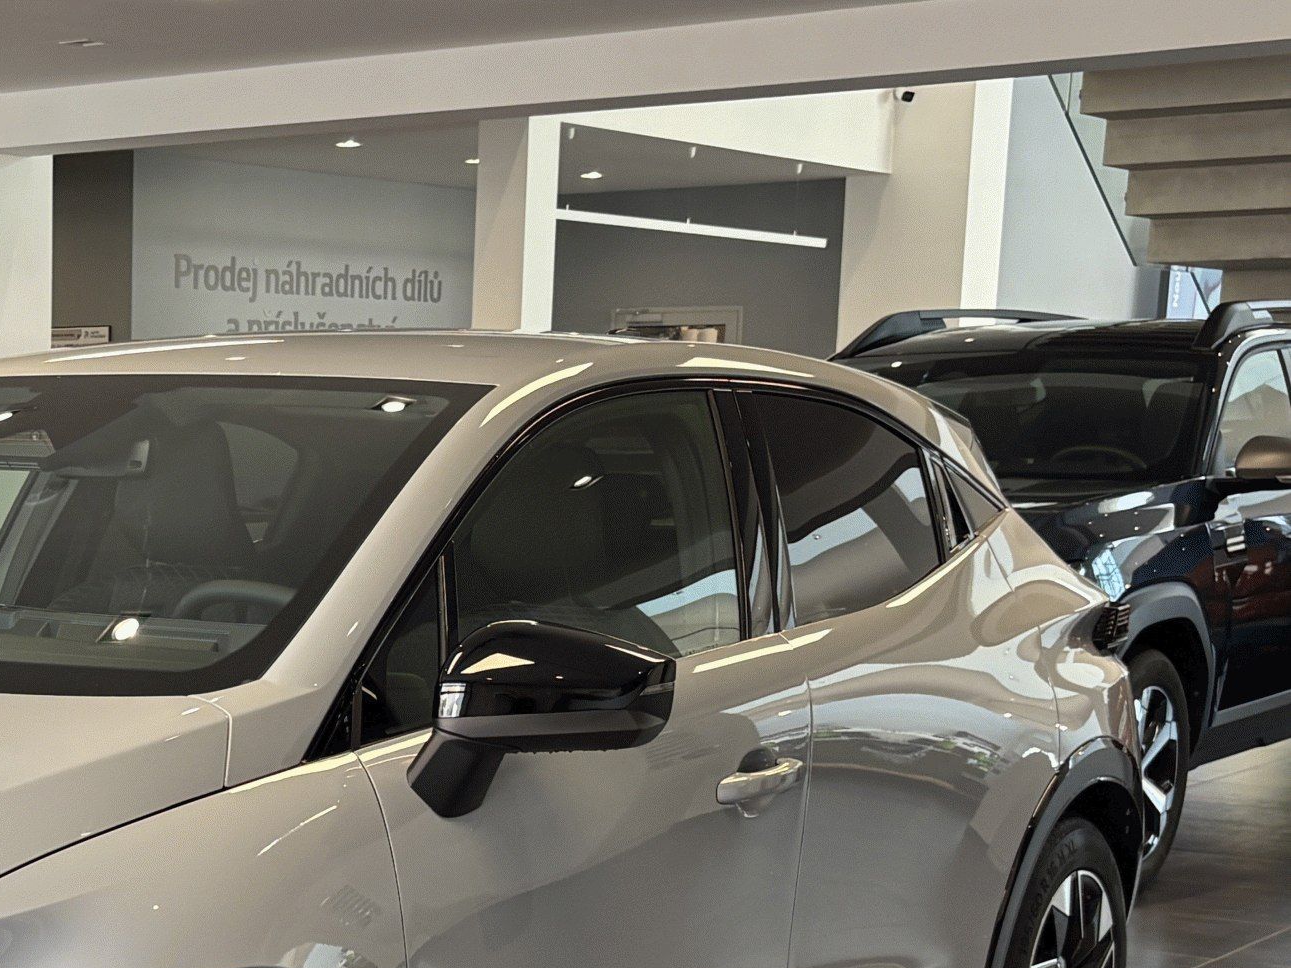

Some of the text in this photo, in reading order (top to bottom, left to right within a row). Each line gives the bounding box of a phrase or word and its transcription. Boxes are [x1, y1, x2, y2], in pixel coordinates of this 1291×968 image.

[173, 253, 442, 303] Prodej náhradních dílů
